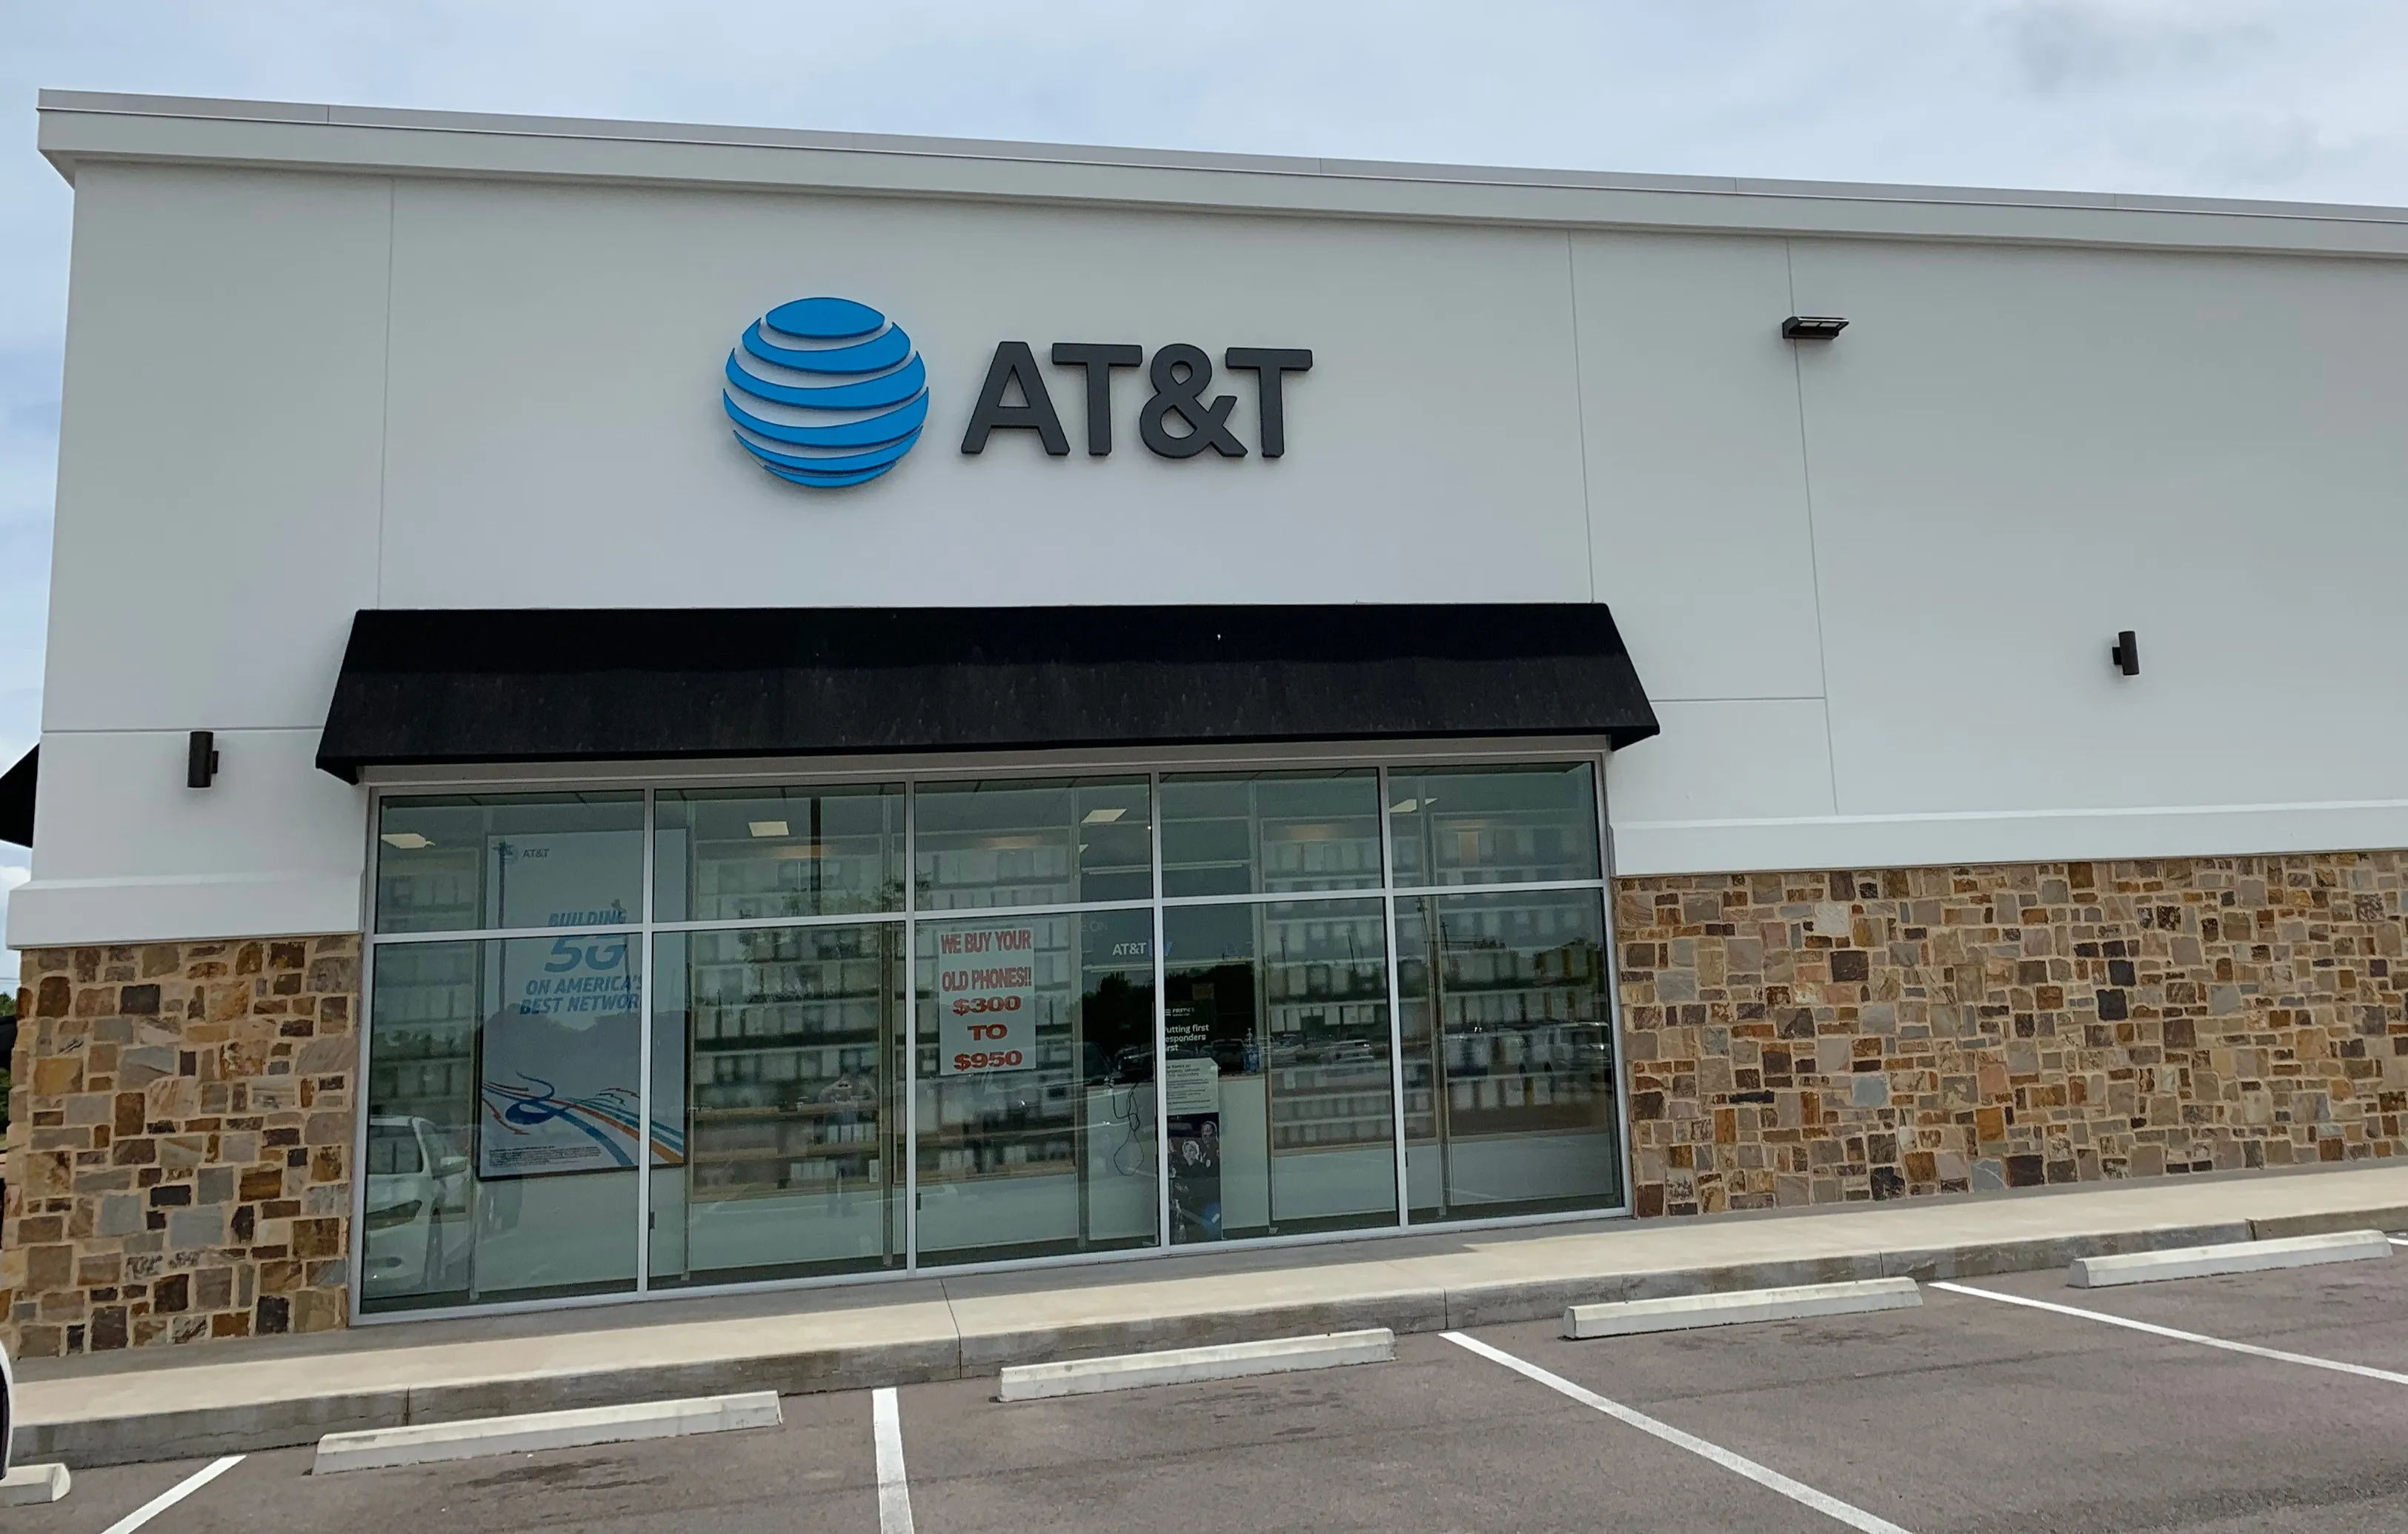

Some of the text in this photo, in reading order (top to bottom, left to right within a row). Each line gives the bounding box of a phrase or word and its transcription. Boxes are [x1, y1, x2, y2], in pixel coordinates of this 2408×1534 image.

[961, 341, 1313, 459] AT&T
[522, 849, 550, 858] AT&T
[941, 929, 1032, 954] WE BUY YOUR
[1112, 942, 1147, 956] AT&T
[545, 934, 627, 972] 5G
[525, 979, 551, 996] ON
[942, 966, 1032, 992] OLD PHONES!!
[520, 993, 640, 1015] BEST NETWOR
[953, 995, 1022, 1016] $300
[967, 1023, 1008, 1041] TO
[1165, 1033, 1206, 1043] esponders
[1192, 1023, 1209, 1032] first
[954, 1050, 1022, 1072] $950
